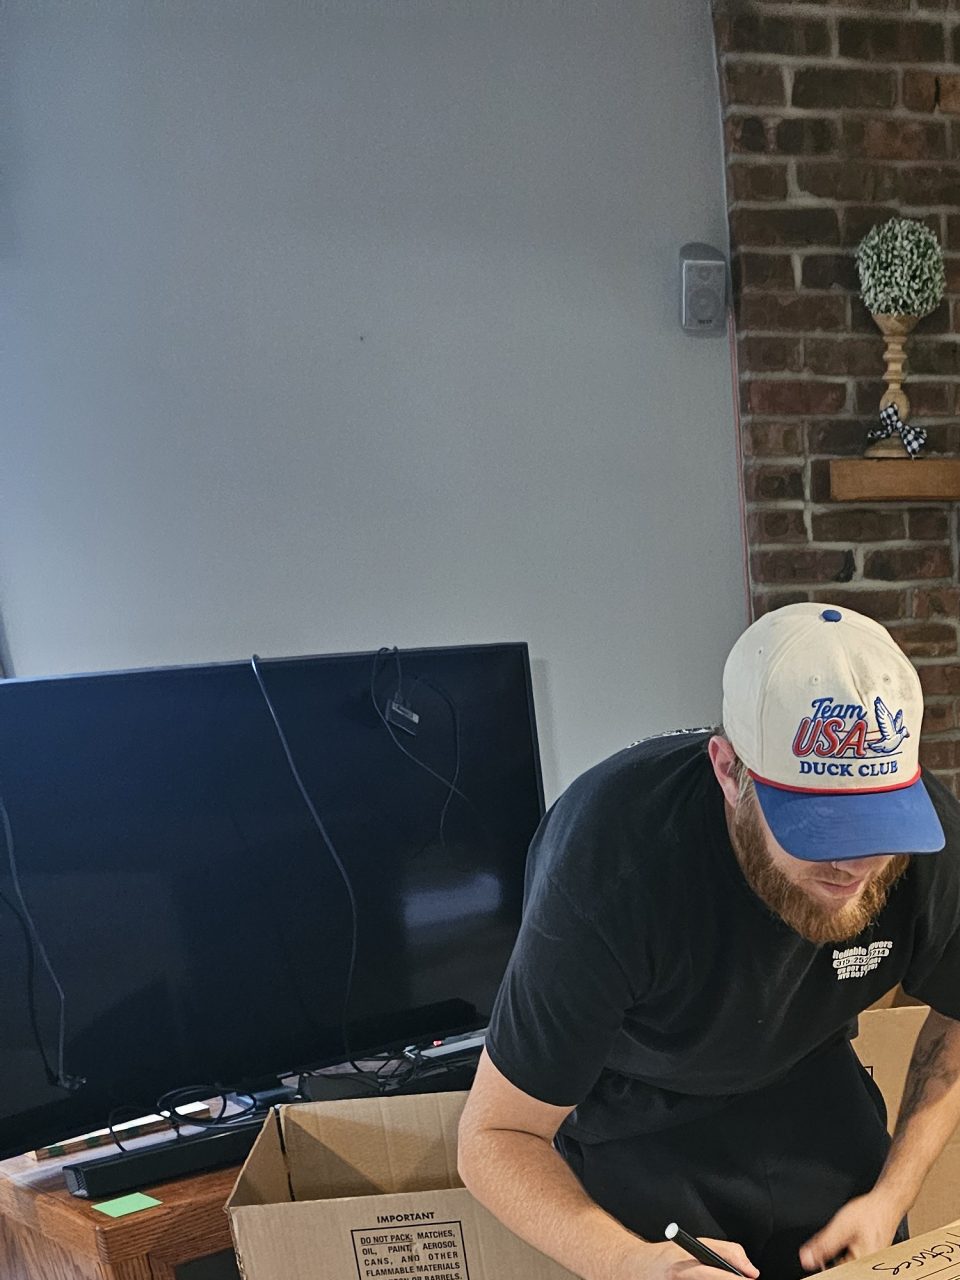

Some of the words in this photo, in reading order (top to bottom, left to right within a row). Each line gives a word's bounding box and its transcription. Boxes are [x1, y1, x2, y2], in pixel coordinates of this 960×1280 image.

[811, 697, 868, 721] Team
[792, 717, 869, 758] USA
[800, 761, 854, 777] DUCK
[858, 760, 898, 777] CLUB
[377, 1211, 435, 1224] IMPORTANT
[360, 1236, 371, 1245] DO
[373, 1235, 388, 1243] NOT
[390, 1233, 413, 1242] PACK:
[417, 1229, 455, 1240] MATCHES,
[362, 1247, 378, 1256] OIL,
[422, 1240, 457, 1250] AEROSOL
[364, 1257, 393, 1267] CANS,
[401, 1254, 420, 1264] AND
[428, 1251, 459, 1261] OTHER
[366, 1266, 415, 1277] FLAMMABLE
[416, 1262, 460, 1273] MATERIALS
